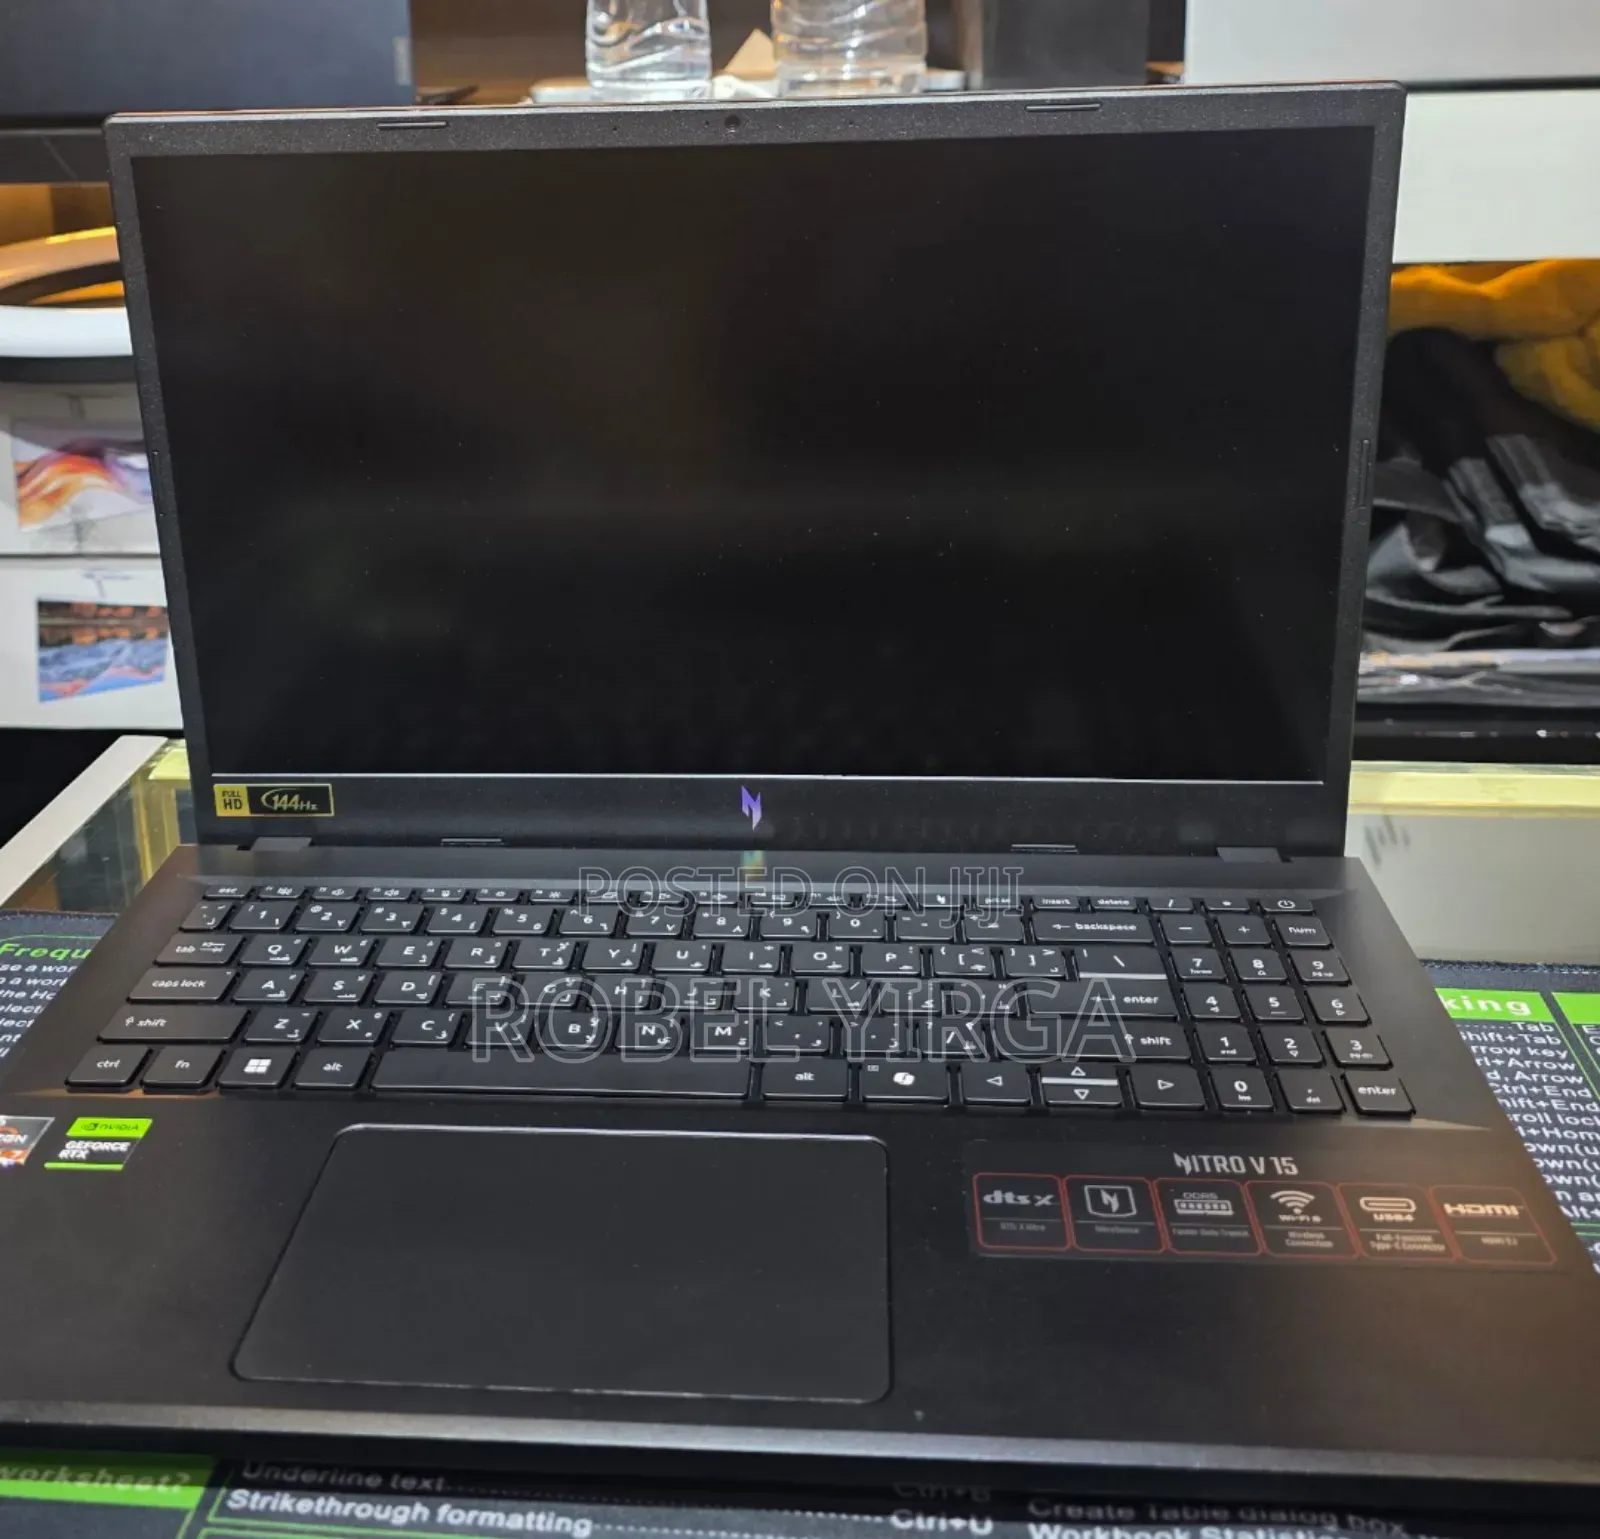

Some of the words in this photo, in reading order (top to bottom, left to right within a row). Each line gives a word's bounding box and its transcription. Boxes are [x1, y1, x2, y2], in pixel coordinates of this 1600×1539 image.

[223, 798, 243, 810] HD
[321, 912, 333, 921] 2
[385, 912, 397, 922] 3
[451, 913, 462, 922] 4
[517, 913, 528, 923] 5
[583, 915, 594, 924] 6
[651, 915, 660, 924] 7
[716, 916, 726, 926] 8
[782, 917, 792, 926] 9
[1074, 922, 1137, 932] backspace
[268, 945, 282, 955] Q
[334, 945, 352, 954] W
[403, 946, 415, 955] E
[471, 947, 484, 956] R
[540, 948, 551, 957] T
[608, 949, 620, 958] Y
[676, 950, 689, 960] U
[813, 951, 827, 961] O
[885, 952, 897, 962] P
[1192, 958, 1202, 967] 7
[1252, 959, 1264, 969] 8
[1312, 961, 1324, 970] 9
[152, 979, 178, 989] caps
[180, 979, 207, 988] lock
[261, 980, 275, 989] A
[332, 980, 345, 991] S
[401, 981, 415, 992] D
[614, 986, 627, 995] H
[759, 988, 771, 997] K
[1123, 996, 1159, 1004] enter
[1205, 996, 1218, 1005] 4
[1269, 997, 1280, 1008] 5
[1331, 999, 1343, 1009] 6
[137, 1018, 167, 1027] shift
[274, 1019, 289, 1029] Z
[346, 1019, 362, 1030] X
[421, 1020, 435, 1030] C
[1510, 1021, 1555, 1032] Tab
[568, 1024, 581, 1034] B
[641, 1025, 656, 1036] N
[714, 1026, 732, 1036] M
[1140, 1036, 1172, 1046] shift
[1220, 1037, 1229, 1047] 1
[1284, 1038, 1297, 1049] 2
[1350, 1040, 1362, 1051] 3
[1526, 1046, 1569, 1059] key
[96, 1059, 121, 1069] ctrl
[175, 1060, 190, 1068] fn
[323, 1062, 343, 1072] alt
[794, 1072, 814, 1081] alt
[1514, 1070, 1584, 1084] Arrow
[1234, 1080, 1248, 1092] 0
[1358, 1086, 1397, 1096] enter
[65, 1140, 131, 1152] GEFORCE
[58, 1149, 90, 1160] RTX
[1172, 1151, 1247, 1176] NITRO
[1249, 1156, 1265, 1175] V
[1269, 1156, 1299, 1176] 15
[1443, 1203, 1520, 1217] HDMI
[242, 1461, 383, 1489] Underline
[390, 1473, 446, 1492] text
[228, 1487, 430, 1526] Strikethrough
[436, 1502, 593, 1538] formatting
[890, 1508, 994, 1536] Ctrl+U
